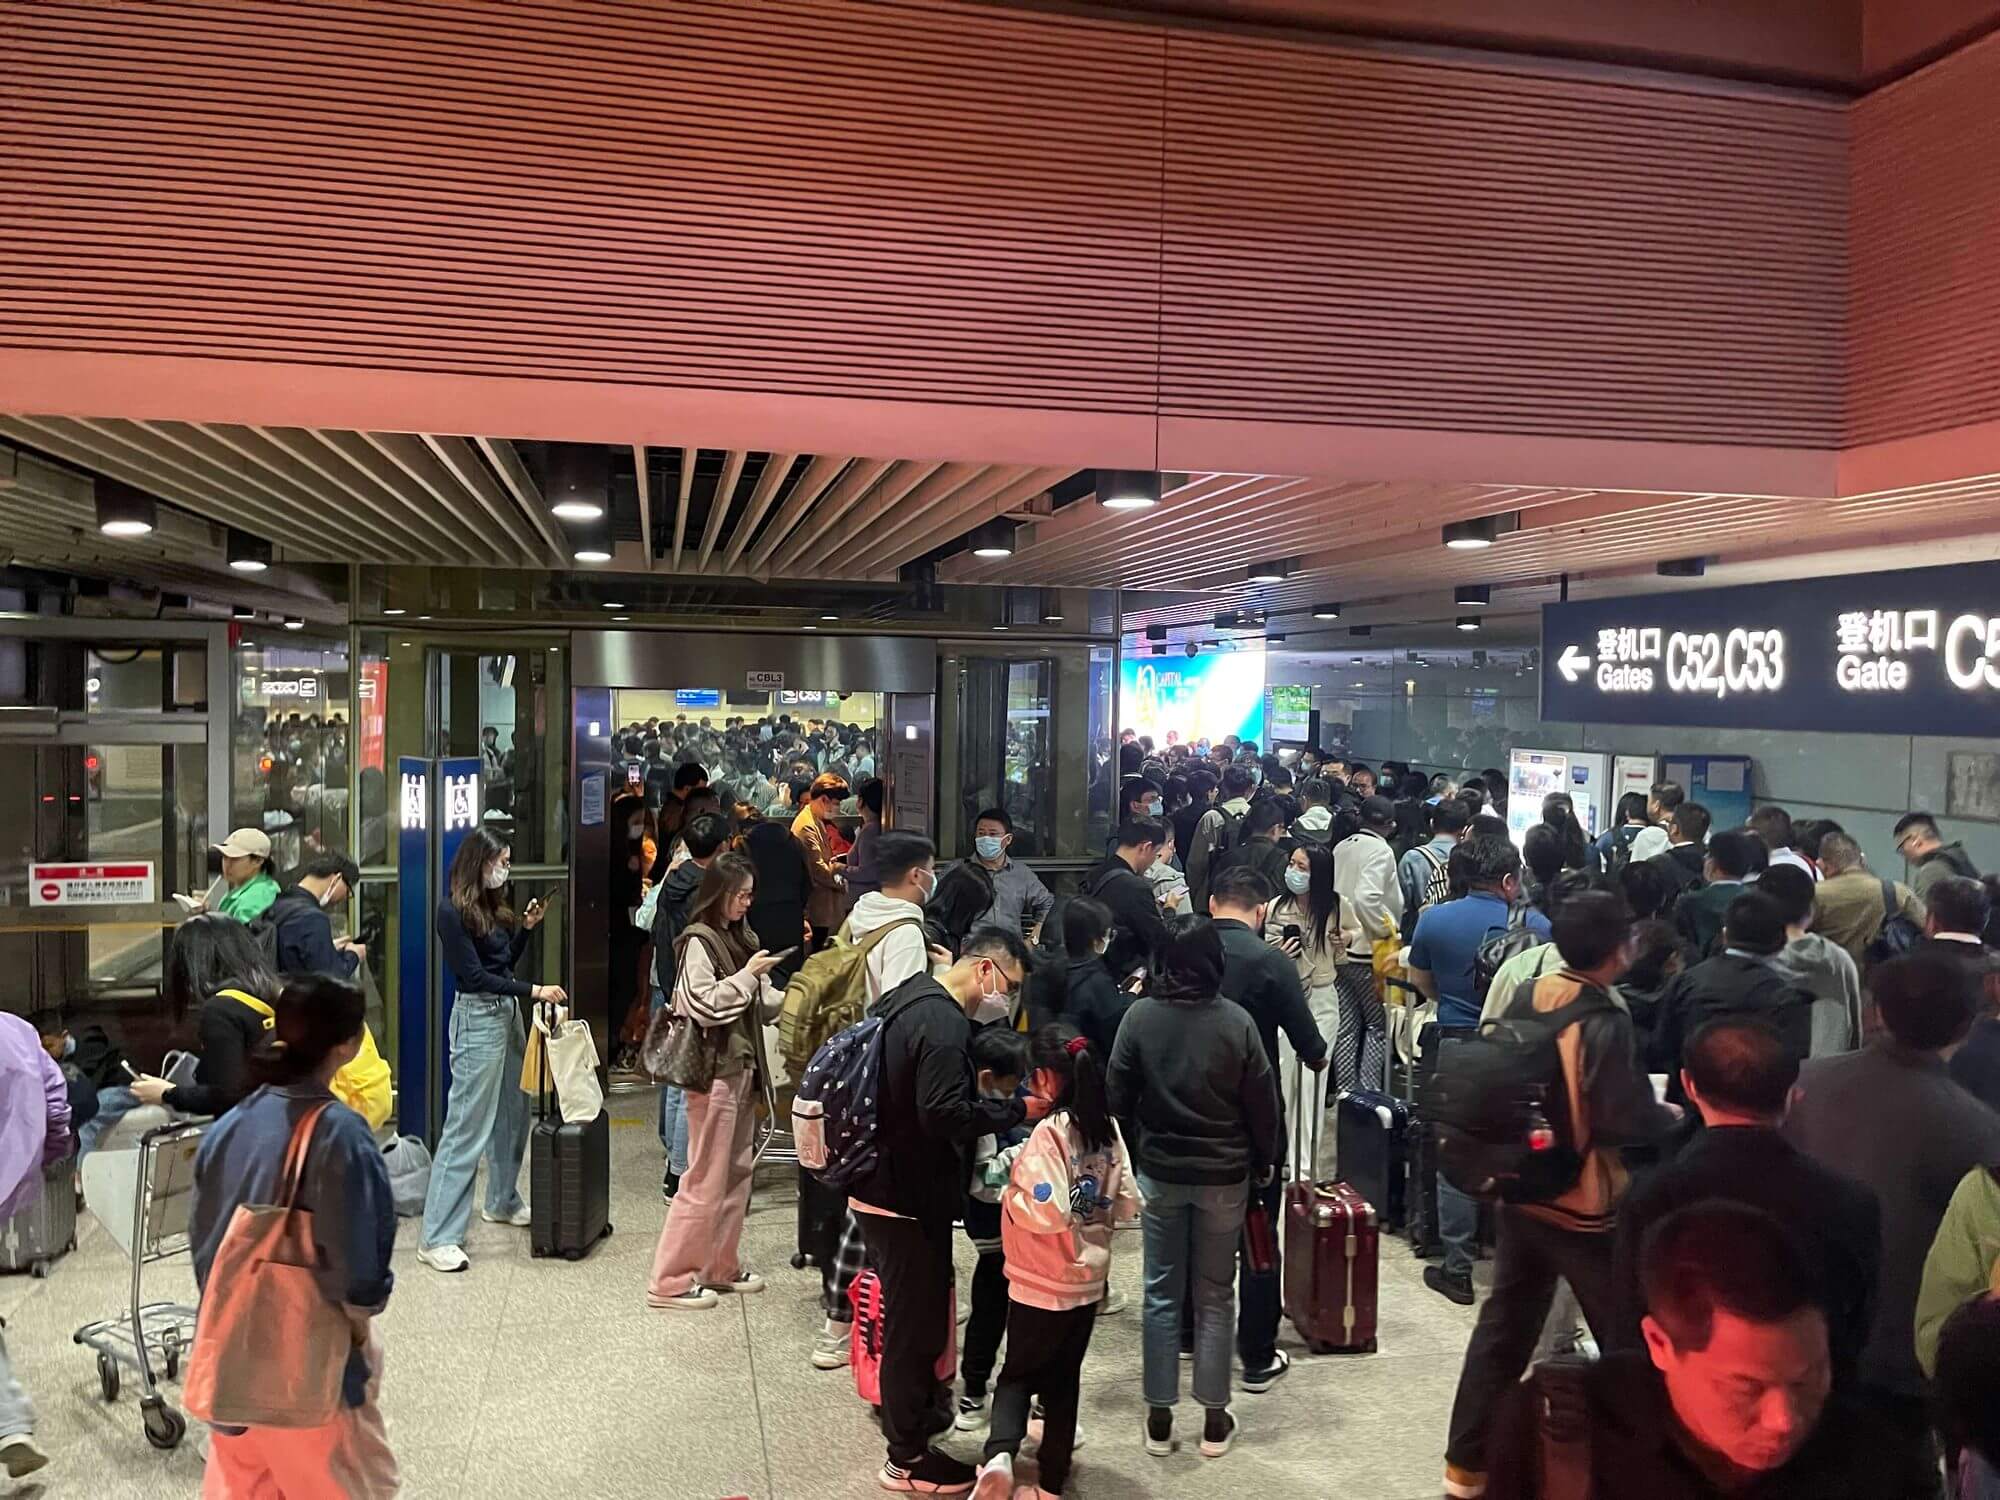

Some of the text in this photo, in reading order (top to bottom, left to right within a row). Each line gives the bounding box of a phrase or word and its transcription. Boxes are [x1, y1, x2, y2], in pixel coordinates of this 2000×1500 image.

[1597, 628, 1661, 661] 登机口
[1836, 610, 1937, 651] 登机口
[1597, 663, 1653, 690] Gates
[1666, 628, 1784, 698] C52,C53
[1836, 655, 1908, 689] Gate
